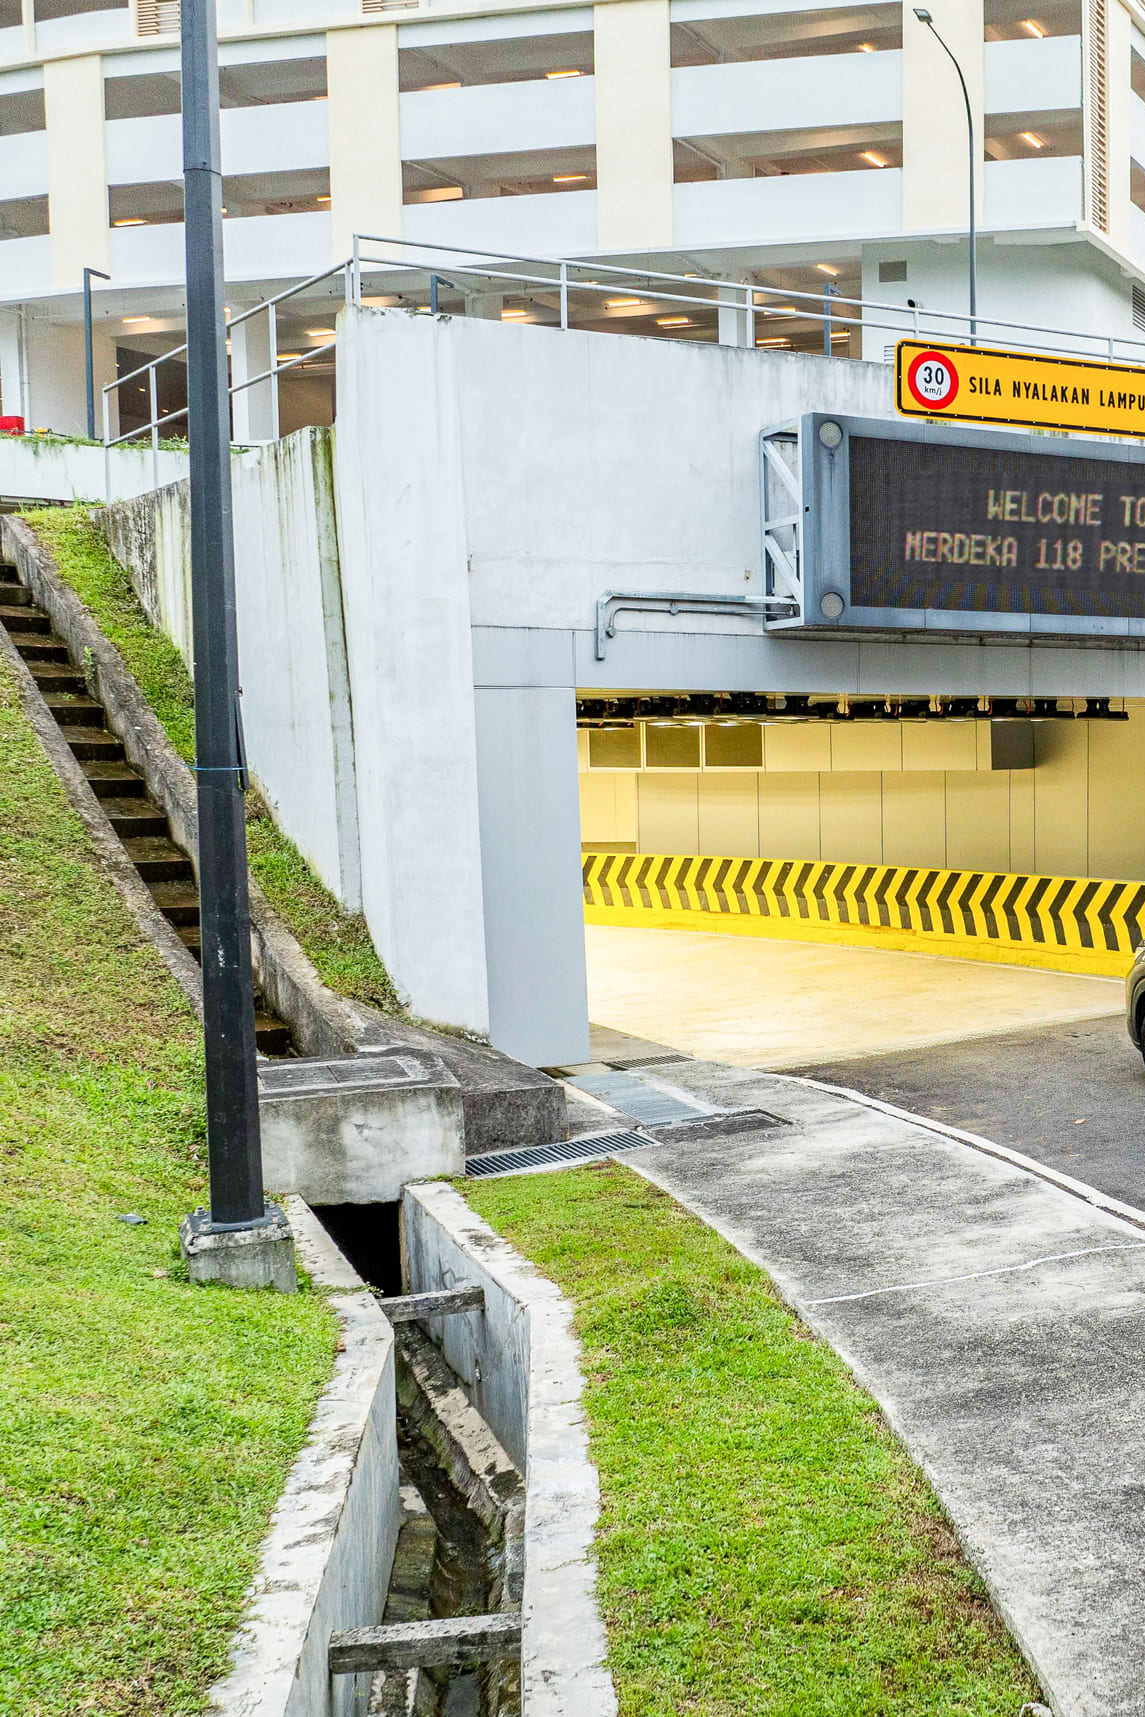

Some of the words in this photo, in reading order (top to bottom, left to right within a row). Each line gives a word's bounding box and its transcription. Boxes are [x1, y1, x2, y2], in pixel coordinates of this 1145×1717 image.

[923, 366, 945, 385] 30
[924, 386, 942, 396] km/j
[969, 376, 1002, 396] SILA
[1012, 381, 1090, 405] NYALAKAN
[1099, 390, 1145, 411] LAMPU
[987, 489, 1103, 526] WELCOME
[905, 530, 1018, 567] MERDEKA
[1034, 538, 1083, 571] 118
